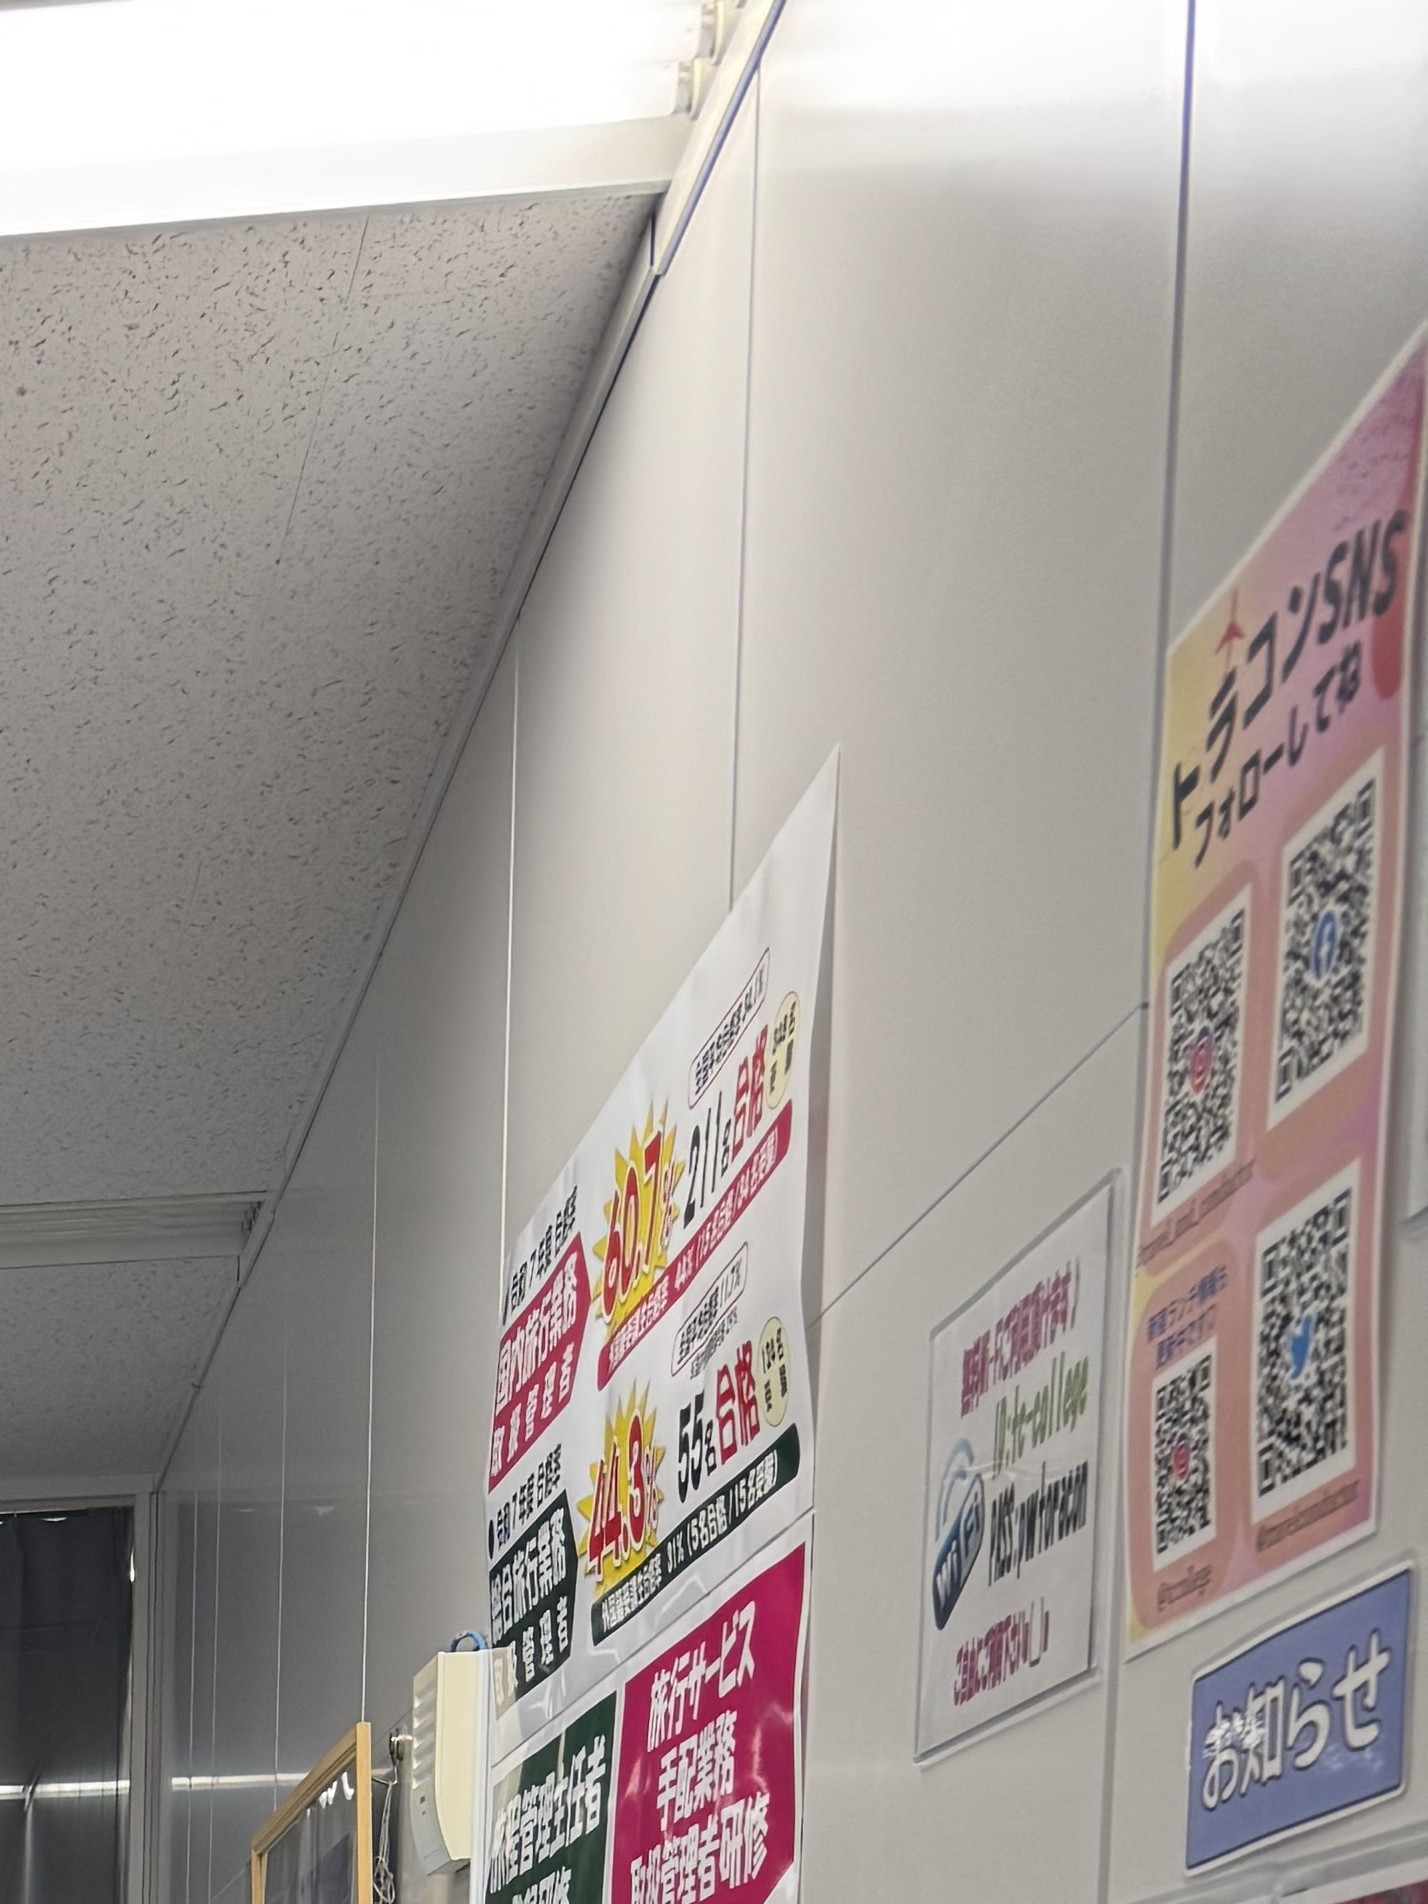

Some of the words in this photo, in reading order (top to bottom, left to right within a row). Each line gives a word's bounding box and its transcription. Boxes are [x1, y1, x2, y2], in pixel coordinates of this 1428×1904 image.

[496, 1252, 578, 1416] 国内旅行業務
[588, 1412, 659, 1578] 44.3%
[678, 1340, 761, 1504] 55名合格
[647, 1600, 756, 1753] 旅行サービス
[1200, 1631, 1393, 1813] お知らせ
[657, 1709, 738, 1832] 手配業務
